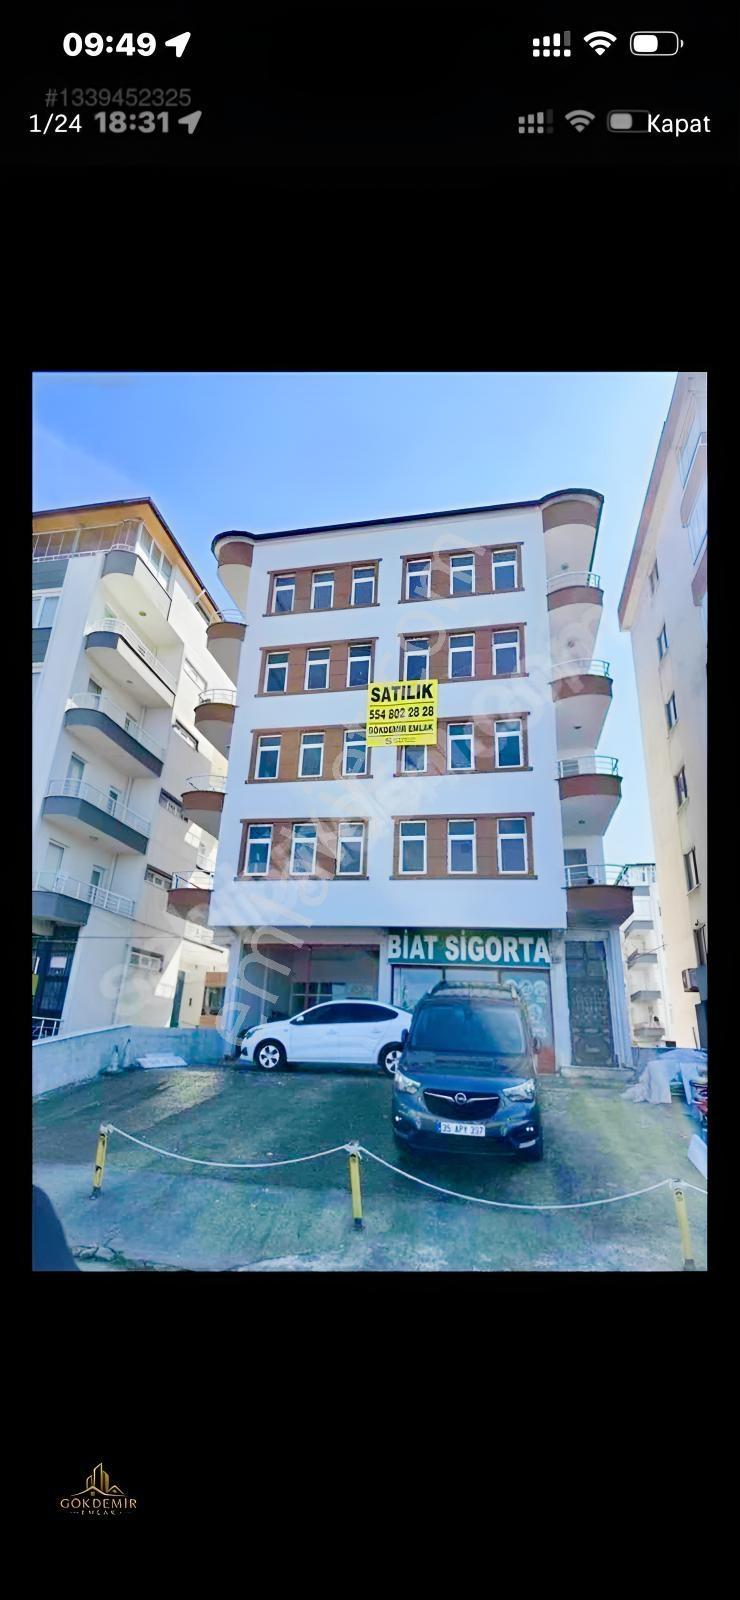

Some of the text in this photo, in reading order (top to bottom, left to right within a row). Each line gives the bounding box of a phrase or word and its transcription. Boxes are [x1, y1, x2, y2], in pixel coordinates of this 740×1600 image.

[371, 683, 433, 702] SATILIK
[369, 706, 434, 720] 554 802 28 28
[388, 929, 550, 963] BİAT SİGORTA
